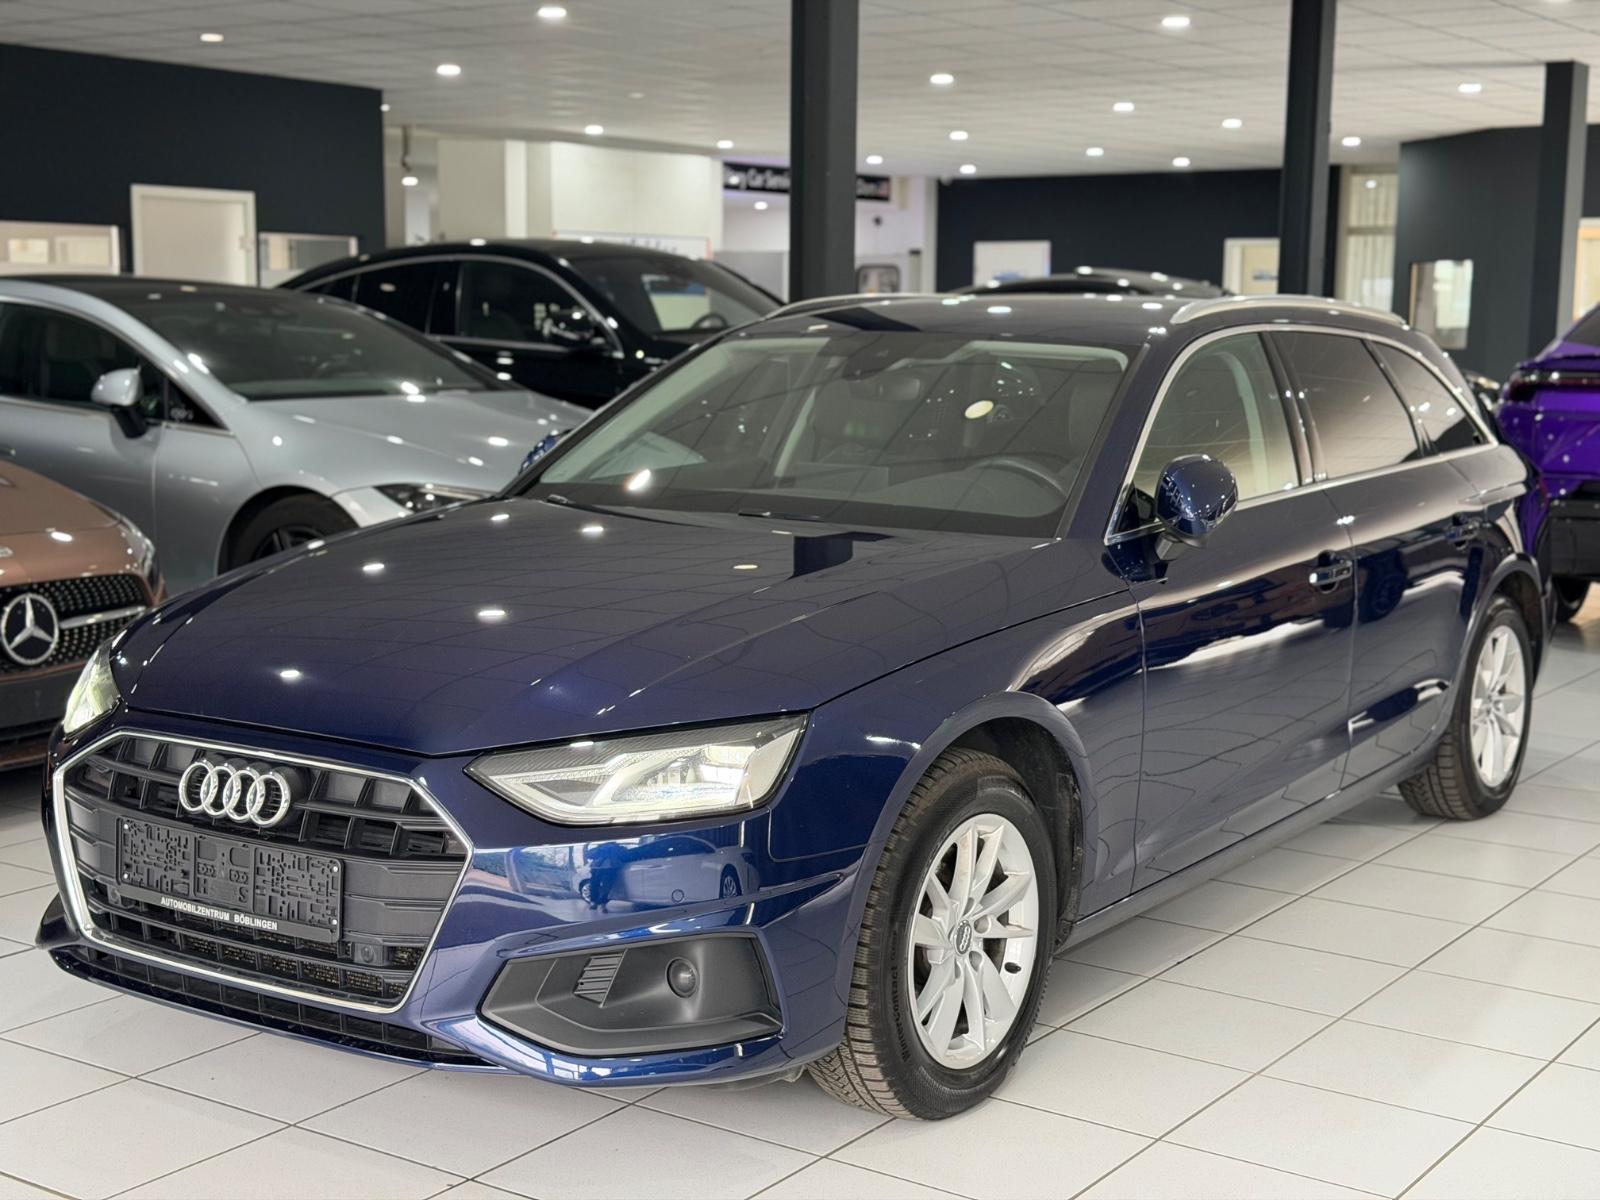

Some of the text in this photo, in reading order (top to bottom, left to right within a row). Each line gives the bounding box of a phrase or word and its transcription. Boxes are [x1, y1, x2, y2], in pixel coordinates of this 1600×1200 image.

[161, 897, 278, 930] AUTOMOBILZENTRUM BÖBLINGEN
[890, 964, 911, 1062] WinterContact
